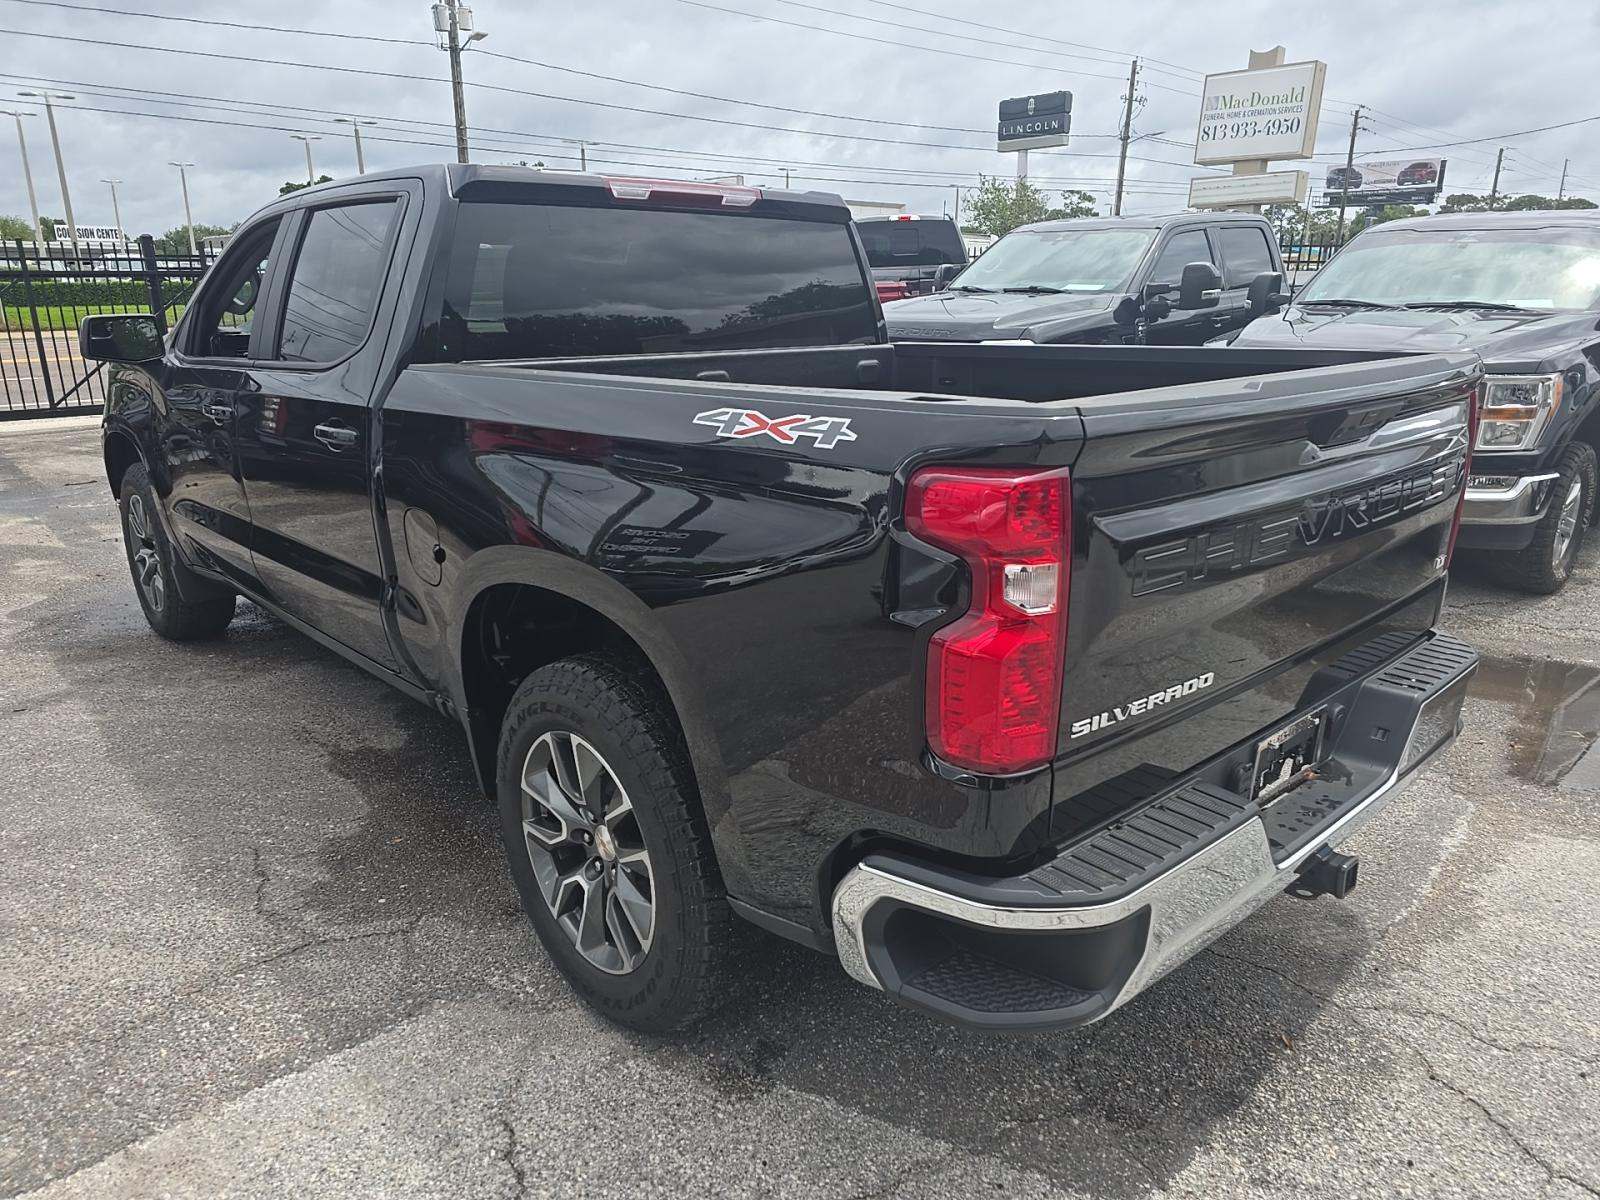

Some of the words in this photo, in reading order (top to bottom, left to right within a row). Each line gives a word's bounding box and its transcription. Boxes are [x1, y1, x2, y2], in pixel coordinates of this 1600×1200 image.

[1219, 86, 1305, 110] MacDonald
[1203, 111, 1226, 121] FUNERAL
[1226, 111, 1241, 119] HOME
[1247, 108, 1276, 117] CREMATION
[1277, 104, 1303, 114] SERVICES
[1003, 120, 1058, 135] LINCOLN
[1201, 123, 1227, 142] 813
[1230, 116, 1301, 140] 933-4950
[56, 227, 95, 239] COLSION
[96, 228, 119, 239] CENTE
[1070, 671, 1215, 739] SILVERADO
